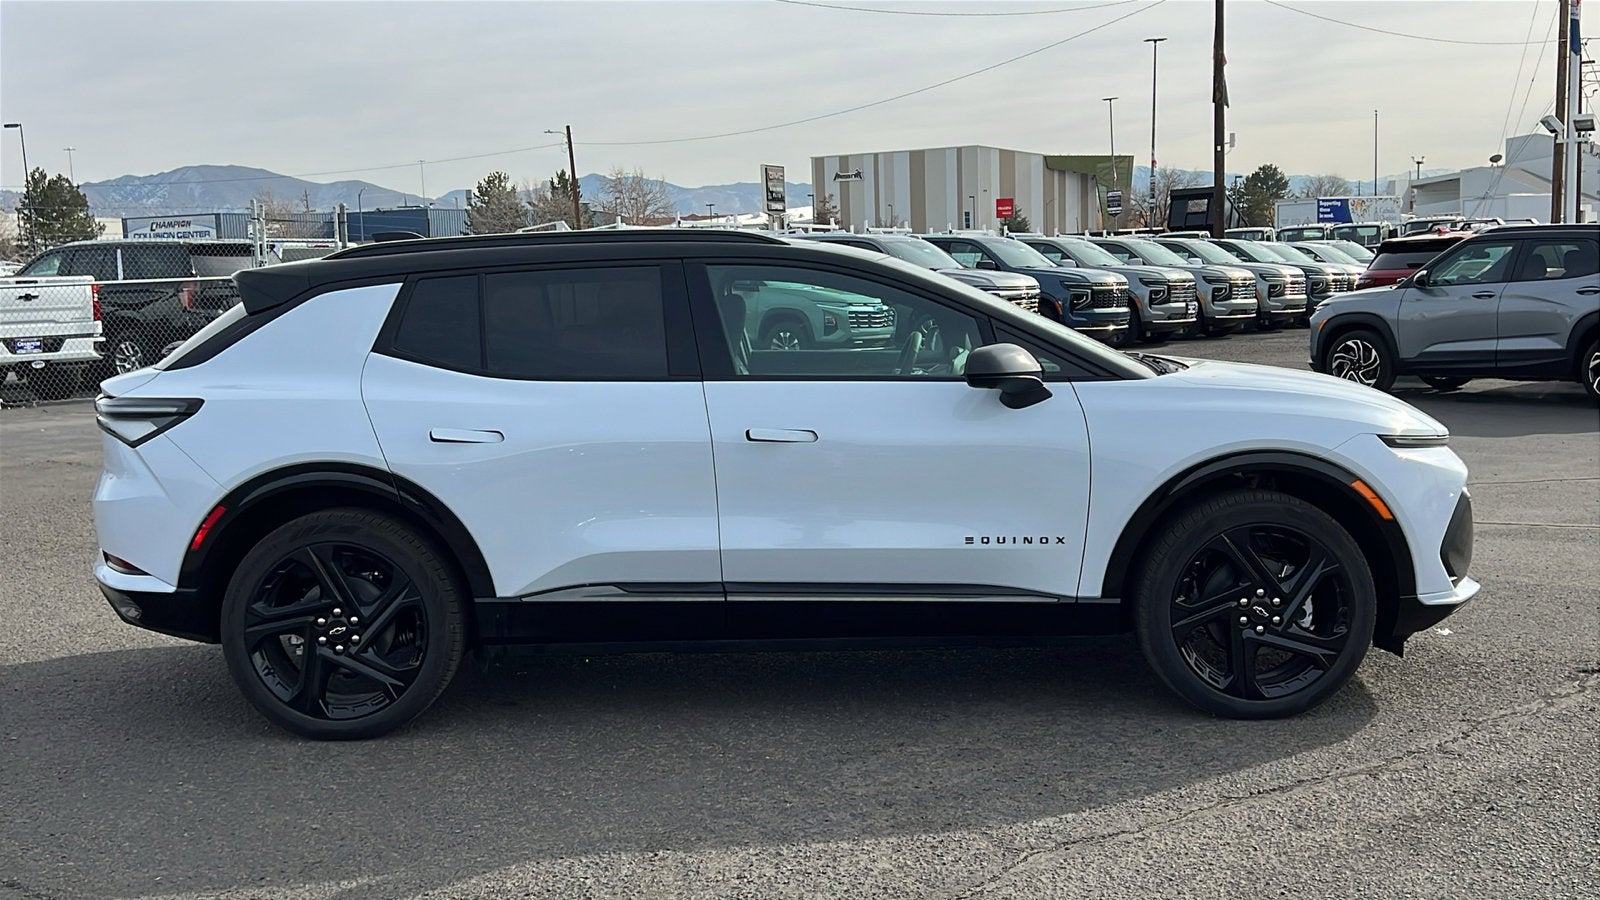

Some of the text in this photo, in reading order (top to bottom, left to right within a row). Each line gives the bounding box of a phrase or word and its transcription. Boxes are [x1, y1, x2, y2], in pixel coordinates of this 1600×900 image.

[150, 220, 192, 231] CHAMPION
[176, 230, 211, 239] CENTER
[964, 536, 1066, 545] EQUINOX
